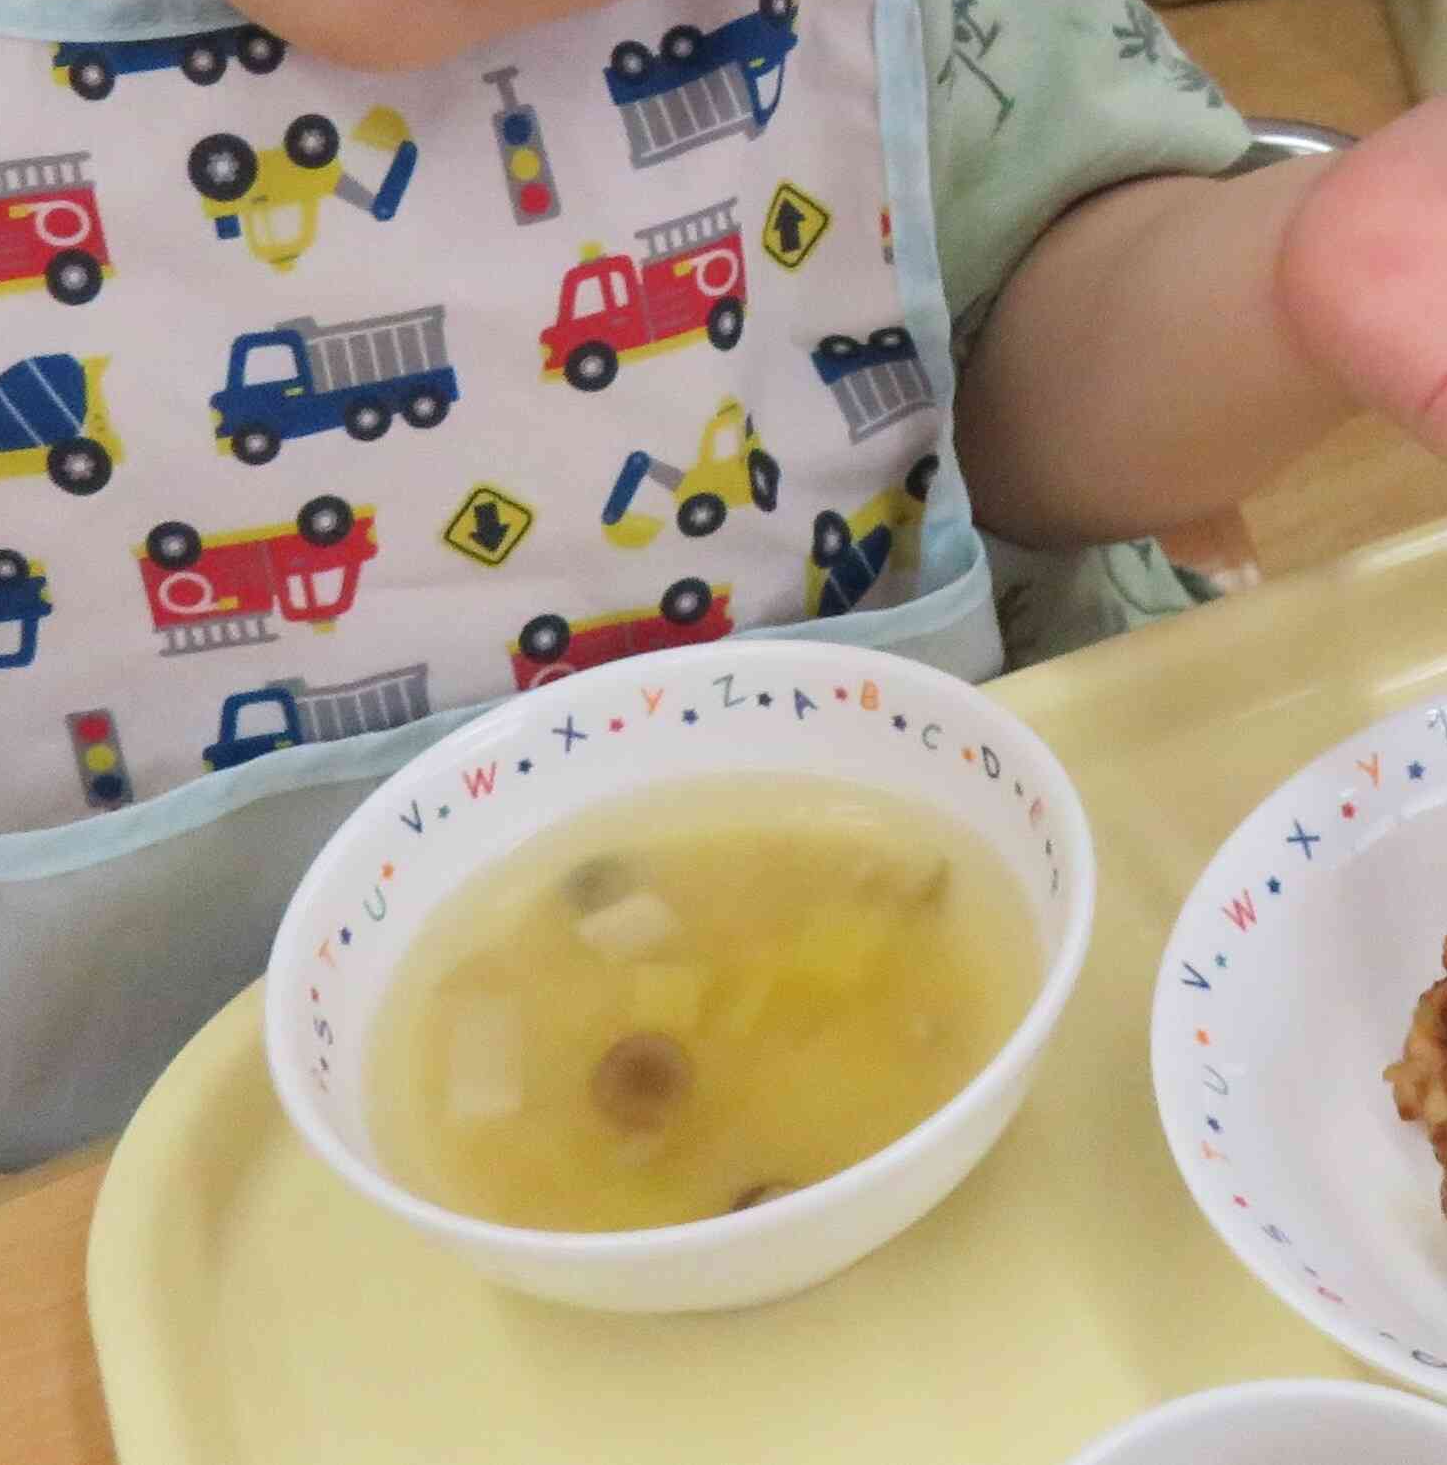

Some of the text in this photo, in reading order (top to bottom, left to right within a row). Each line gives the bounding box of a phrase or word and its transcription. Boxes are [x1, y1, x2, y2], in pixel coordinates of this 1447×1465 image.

[1356, 753, 1380, 789] Y
[363, 885, 386, 921] U
[400, 800, 423, 834] V
[462, 760, 497, 799] W
[552, 715, 588, 753] X
[641, 687, 664, 716] Y
[713, 673, 748, 708] Z
[793, 688, 818, 720] A
[860, 679, 880, 711] B
[922, 723, 942, 750] C
[981, 744, 1000, 779] D
[1286, 819, 1320, 861] X
[1222, 888, 1257, 932] W
[1181, 961, 1211, 991] V
[1203, 1063, 1229, 1096] U
